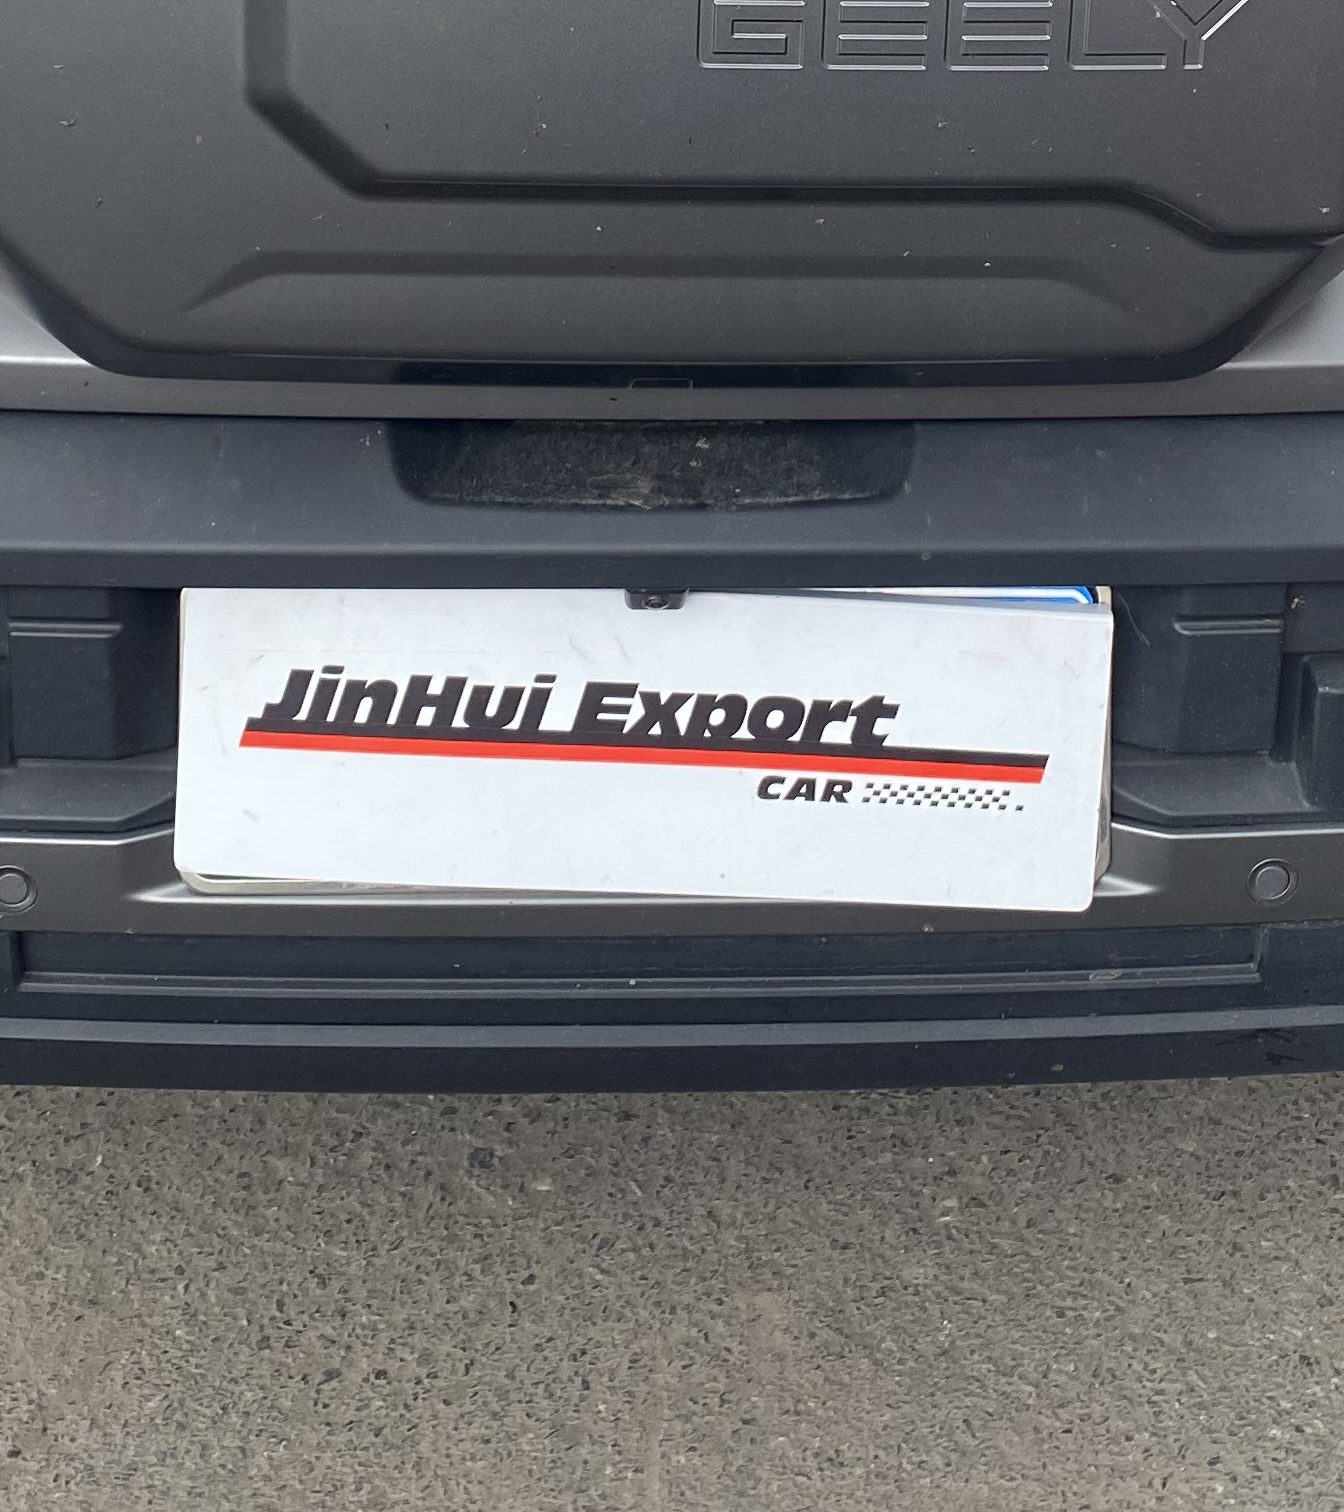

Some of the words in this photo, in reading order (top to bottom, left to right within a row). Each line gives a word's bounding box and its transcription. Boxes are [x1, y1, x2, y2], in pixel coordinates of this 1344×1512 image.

[258, 663, 558, 734] JinHui
[572, 681, 901, 748] Export
[754, 774, 854, 805] CAR
